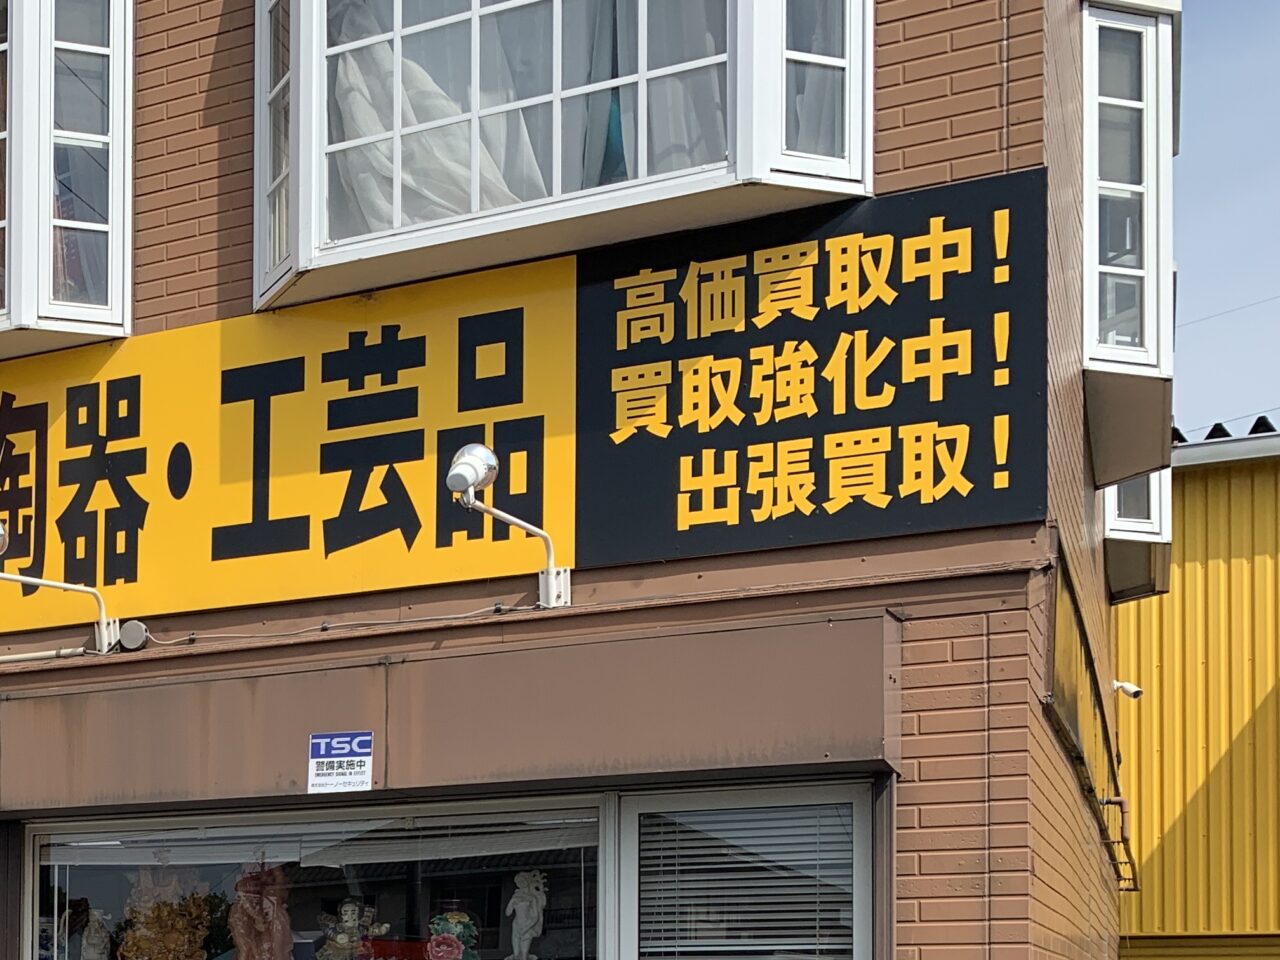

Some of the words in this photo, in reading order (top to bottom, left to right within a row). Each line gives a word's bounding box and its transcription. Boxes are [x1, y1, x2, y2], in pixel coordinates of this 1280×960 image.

[613, 208, 1010, 351] 高価買取中!
[609, 311, 1010, 445] 買取強化中!
[677, 415, 1010, 531] 出張買取!
[311, 735, 372, 755] TSC
